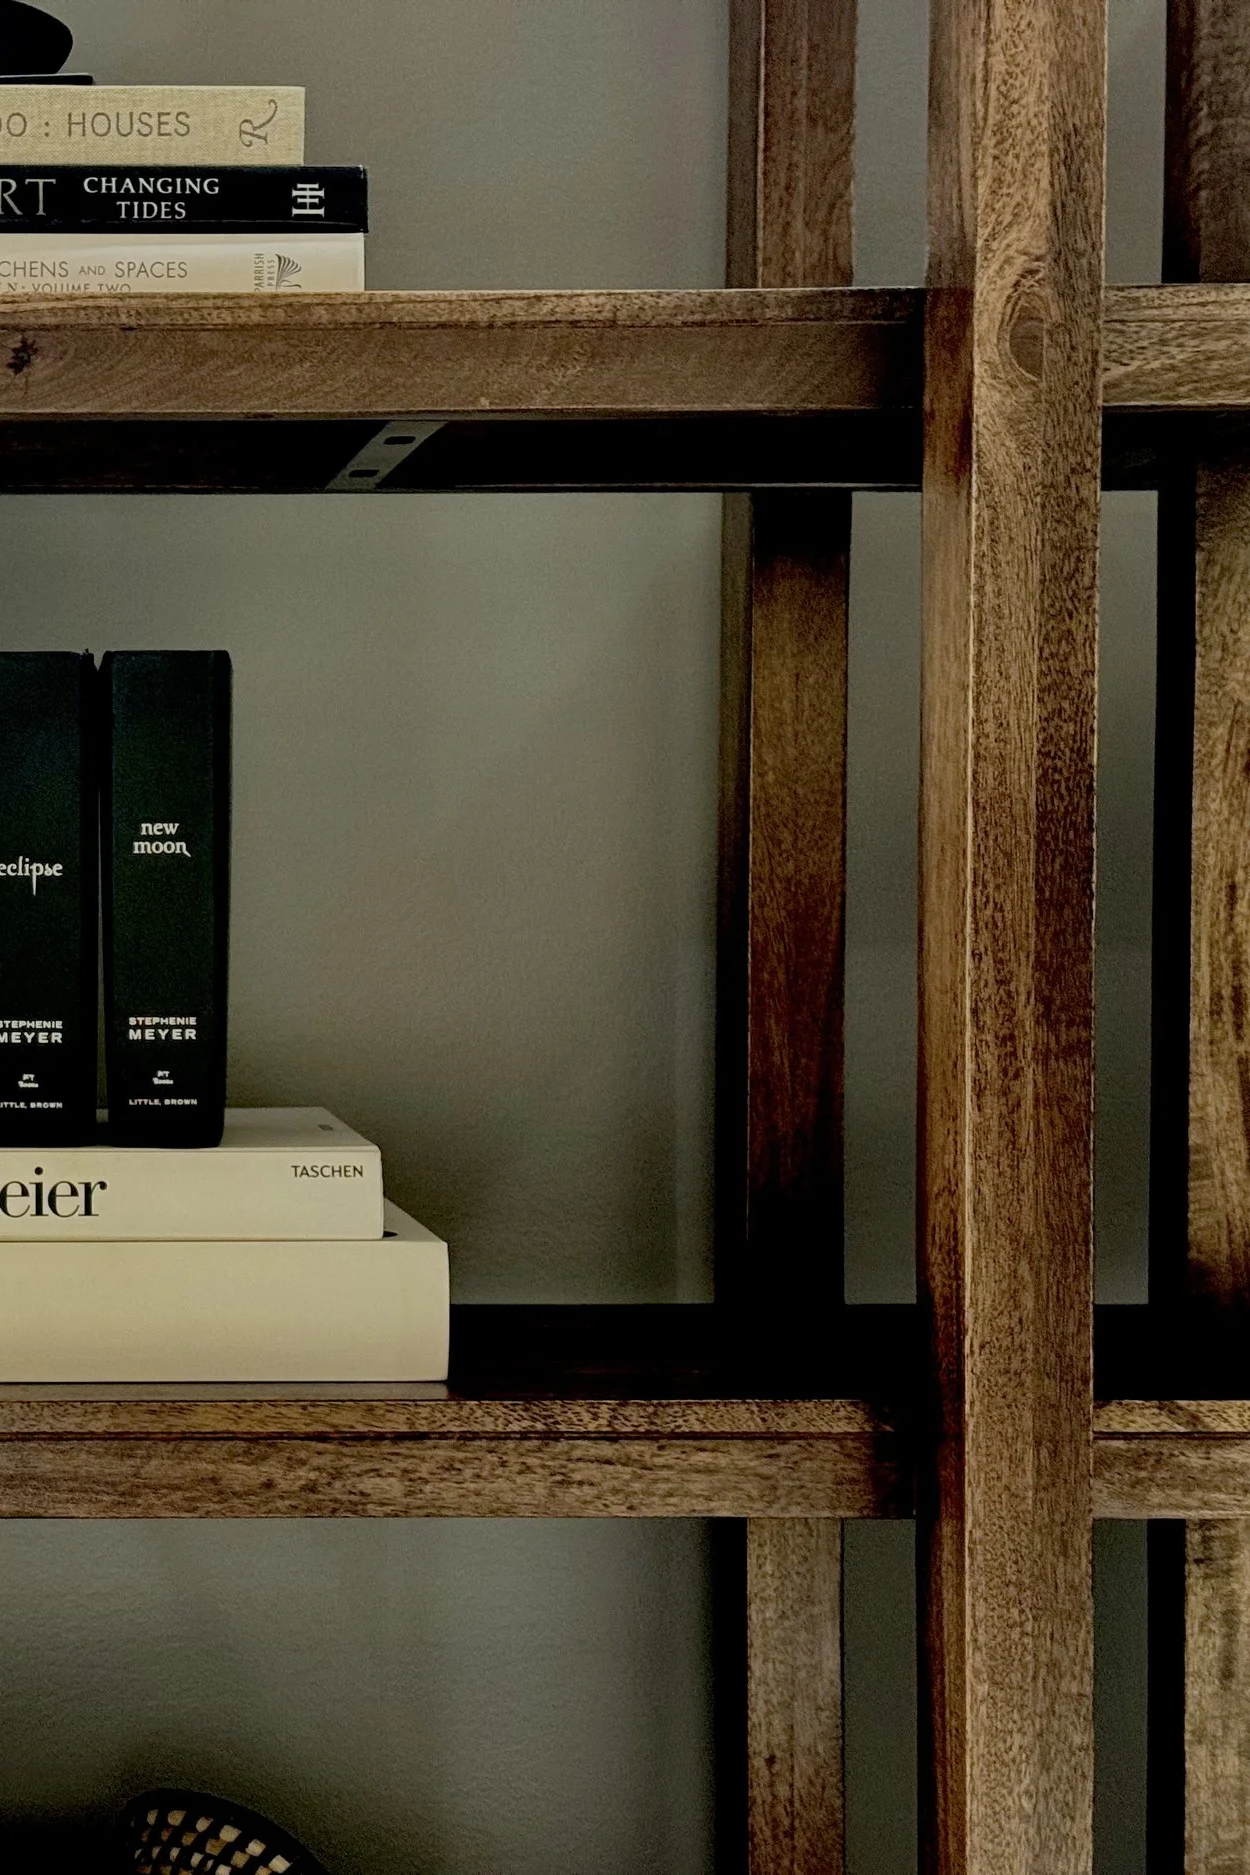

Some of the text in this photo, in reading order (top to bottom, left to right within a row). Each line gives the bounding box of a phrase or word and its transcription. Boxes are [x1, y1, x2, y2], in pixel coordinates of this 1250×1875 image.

[67, 112, 190, 137] HOUSES
[83, 176, 220, 195] CHANGING
[116, 201, 186, 220] TIDES
[77, 265, 106, 276] AND
[114, 260, 188, 279] SPACES
[266, 259, 276, 287] PRESS
[140, 822, 180, 836] new
[132, 840, 192, 858] moon
[128, 1016, 197, 1026] STEPHENIE
[128, 1028, 197, 1041] MEYER
[29, 1101, 63, 1109] BROWN
[163, 1098, 198, 1106] BROWN
[290, 1164, 364, 1178] TASCHEN
